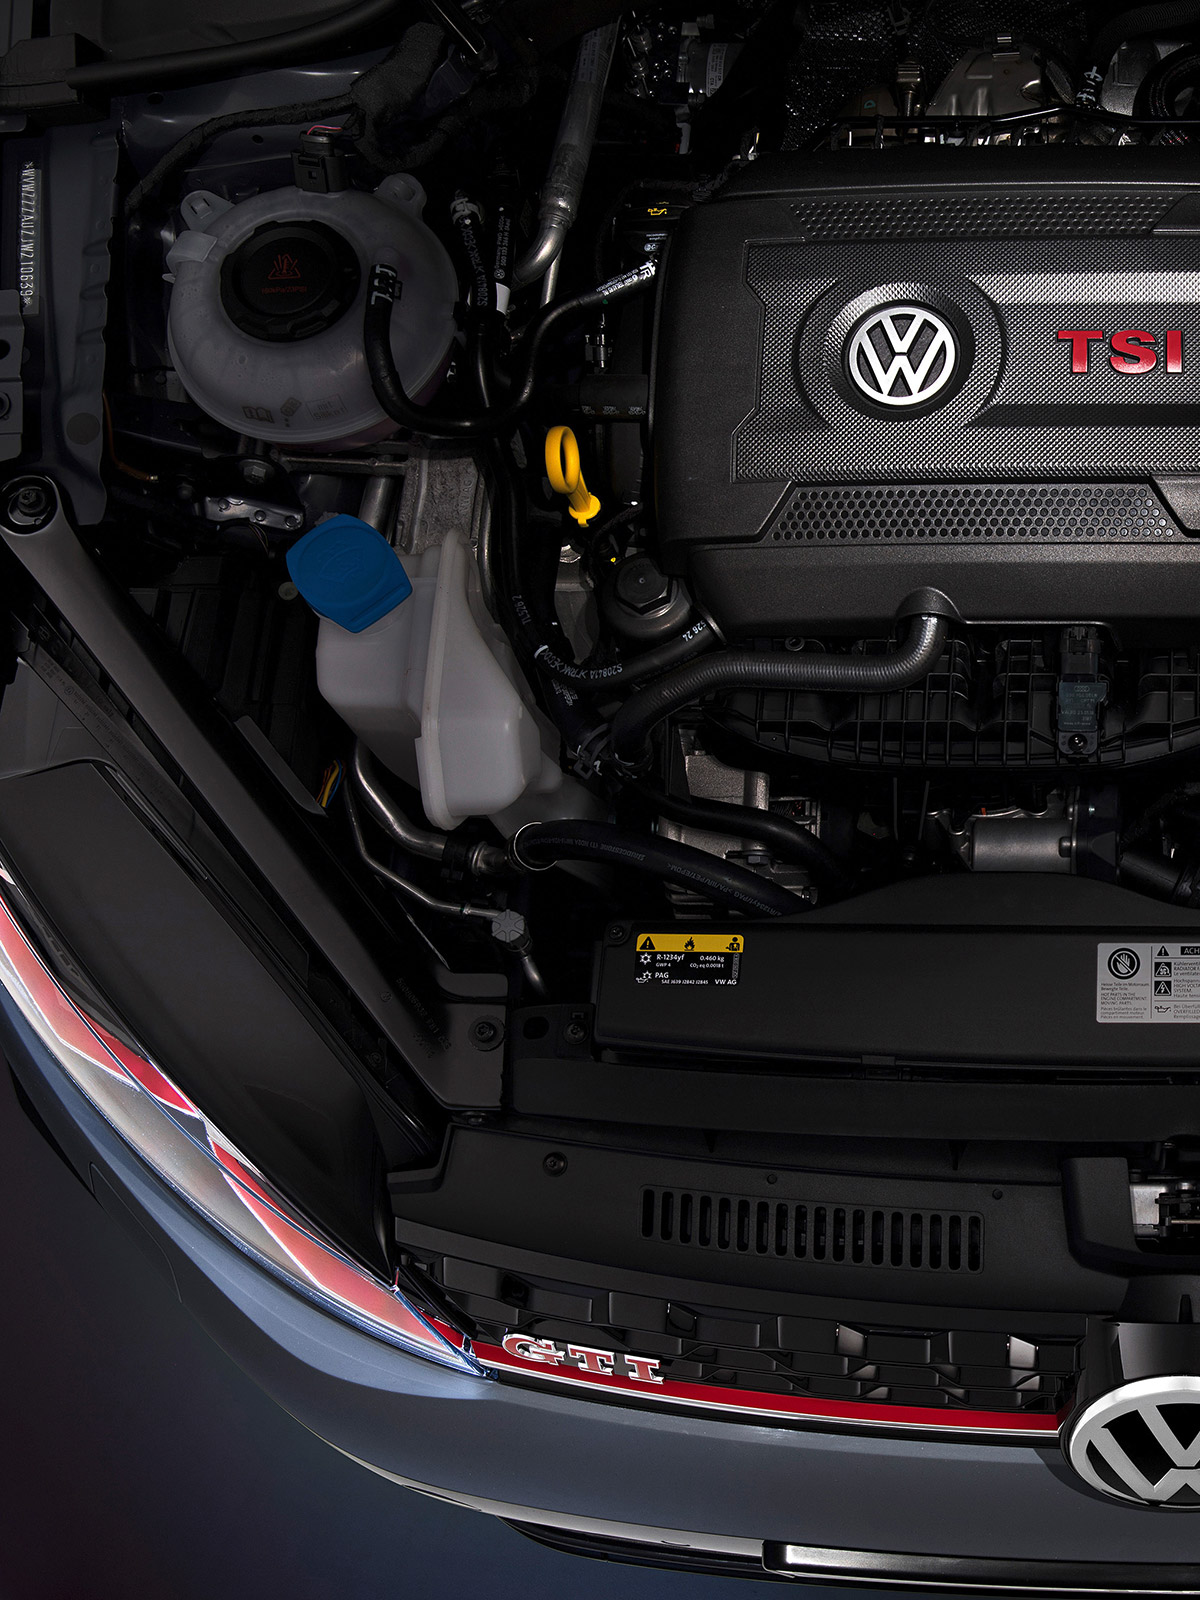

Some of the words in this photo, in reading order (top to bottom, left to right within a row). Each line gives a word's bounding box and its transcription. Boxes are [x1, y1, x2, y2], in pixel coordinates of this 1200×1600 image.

[1057, 329, 1185, 376] TSI
[656, 954, 686, 962] R-1234yf
[500, 1332, 667, 1385] GTI
